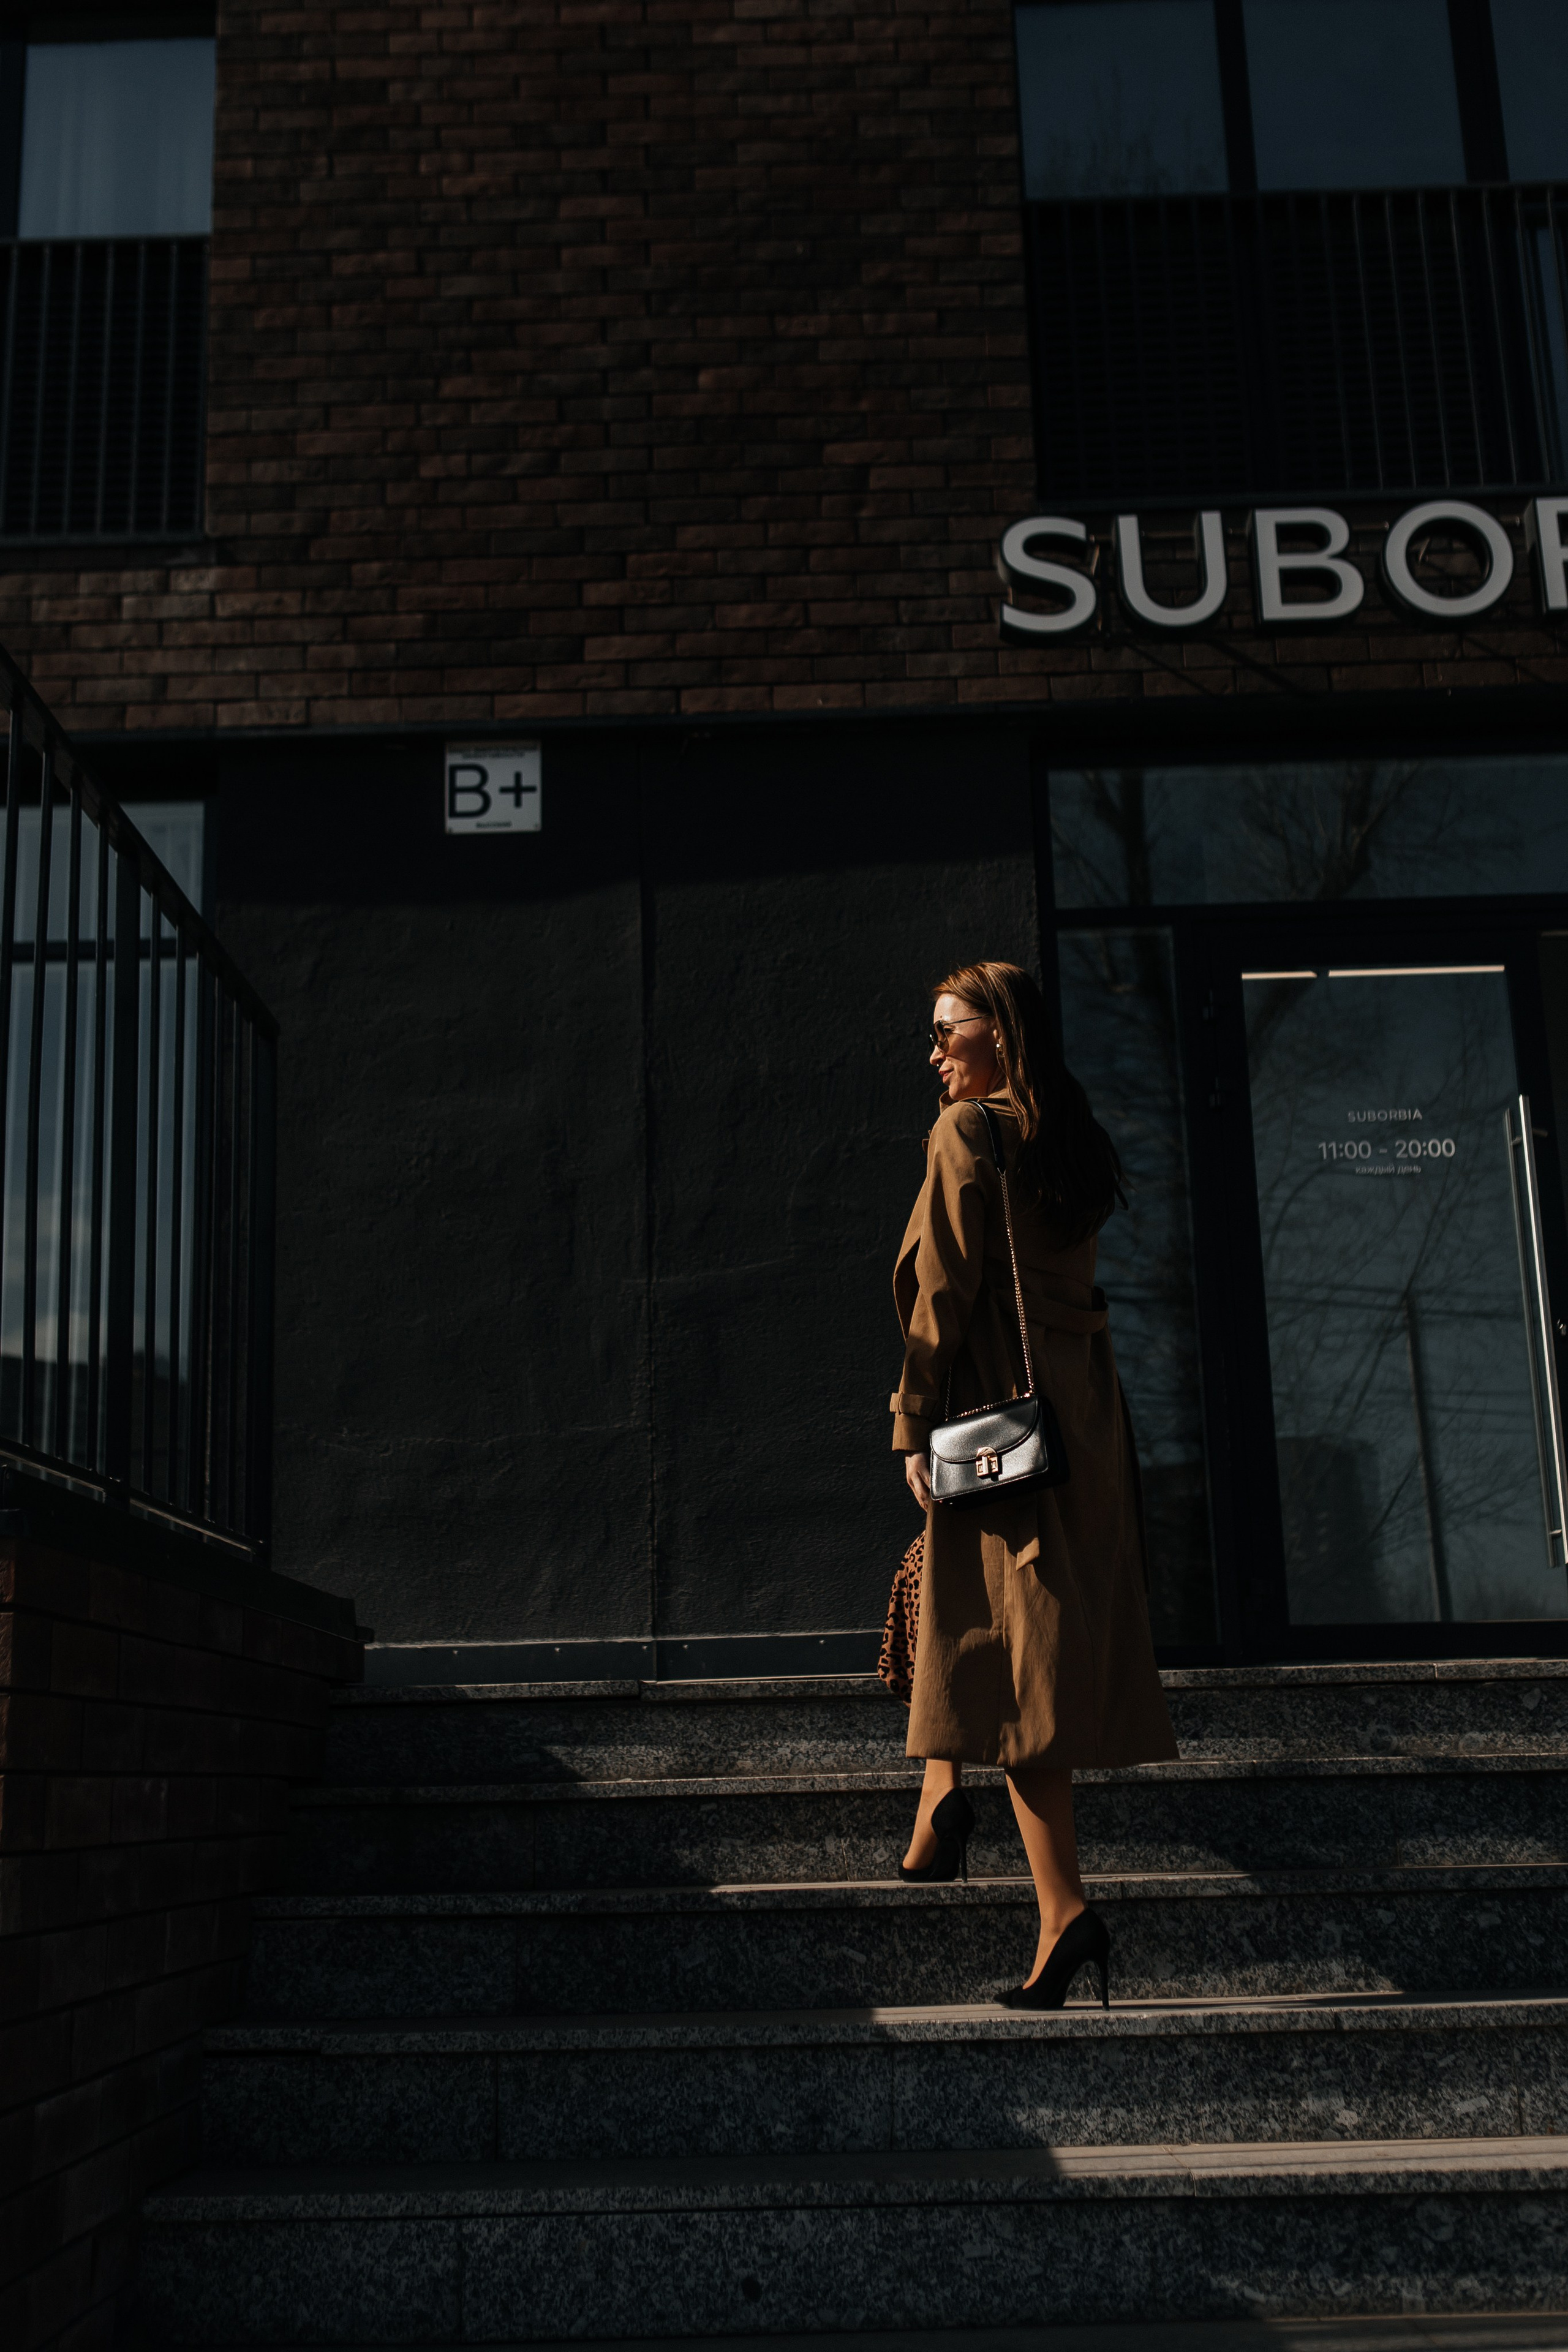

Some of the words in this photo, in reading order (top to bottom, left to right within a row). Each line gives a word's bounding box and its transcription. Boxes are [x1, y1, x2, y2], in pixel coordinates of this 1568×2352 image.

[448, 763, 537, 818] B+
[1348, 1108, 1423, 1123] SUBORBIA
[1317, 1140, 1372, 1160] 11:00
[1395, 1138, 1456, 1158] 20:00
[1355, 1163, 1395, 1175] каждый
[1397, 1165, 1422, 1175] день
